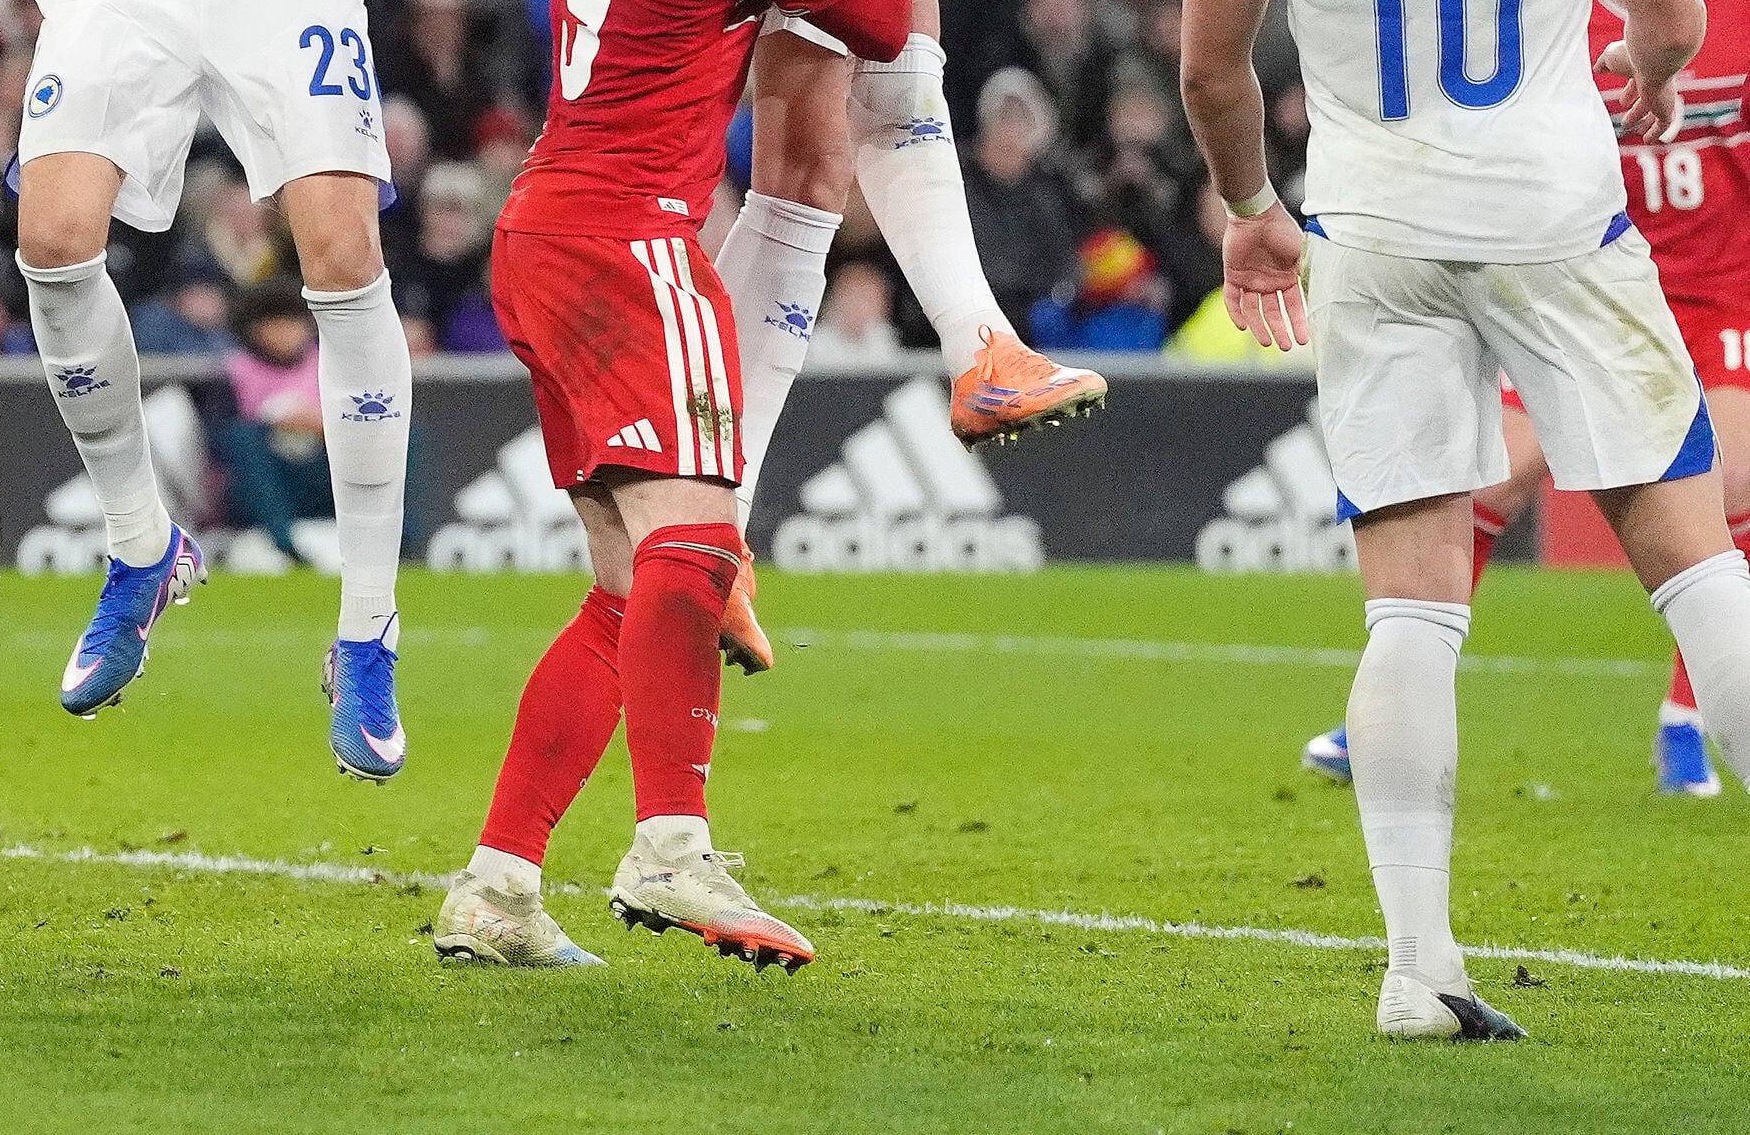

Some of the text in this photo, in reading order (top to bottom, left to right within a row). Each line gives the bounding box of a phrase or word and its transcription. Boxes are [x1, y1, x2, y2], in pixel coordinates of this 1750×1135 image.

[299, 25, 372, 101] 23
[1635, 145, 1706, 214] 18
[764, 315, 811, 343] KELM
[771, 502, 1046, 575] adidas
